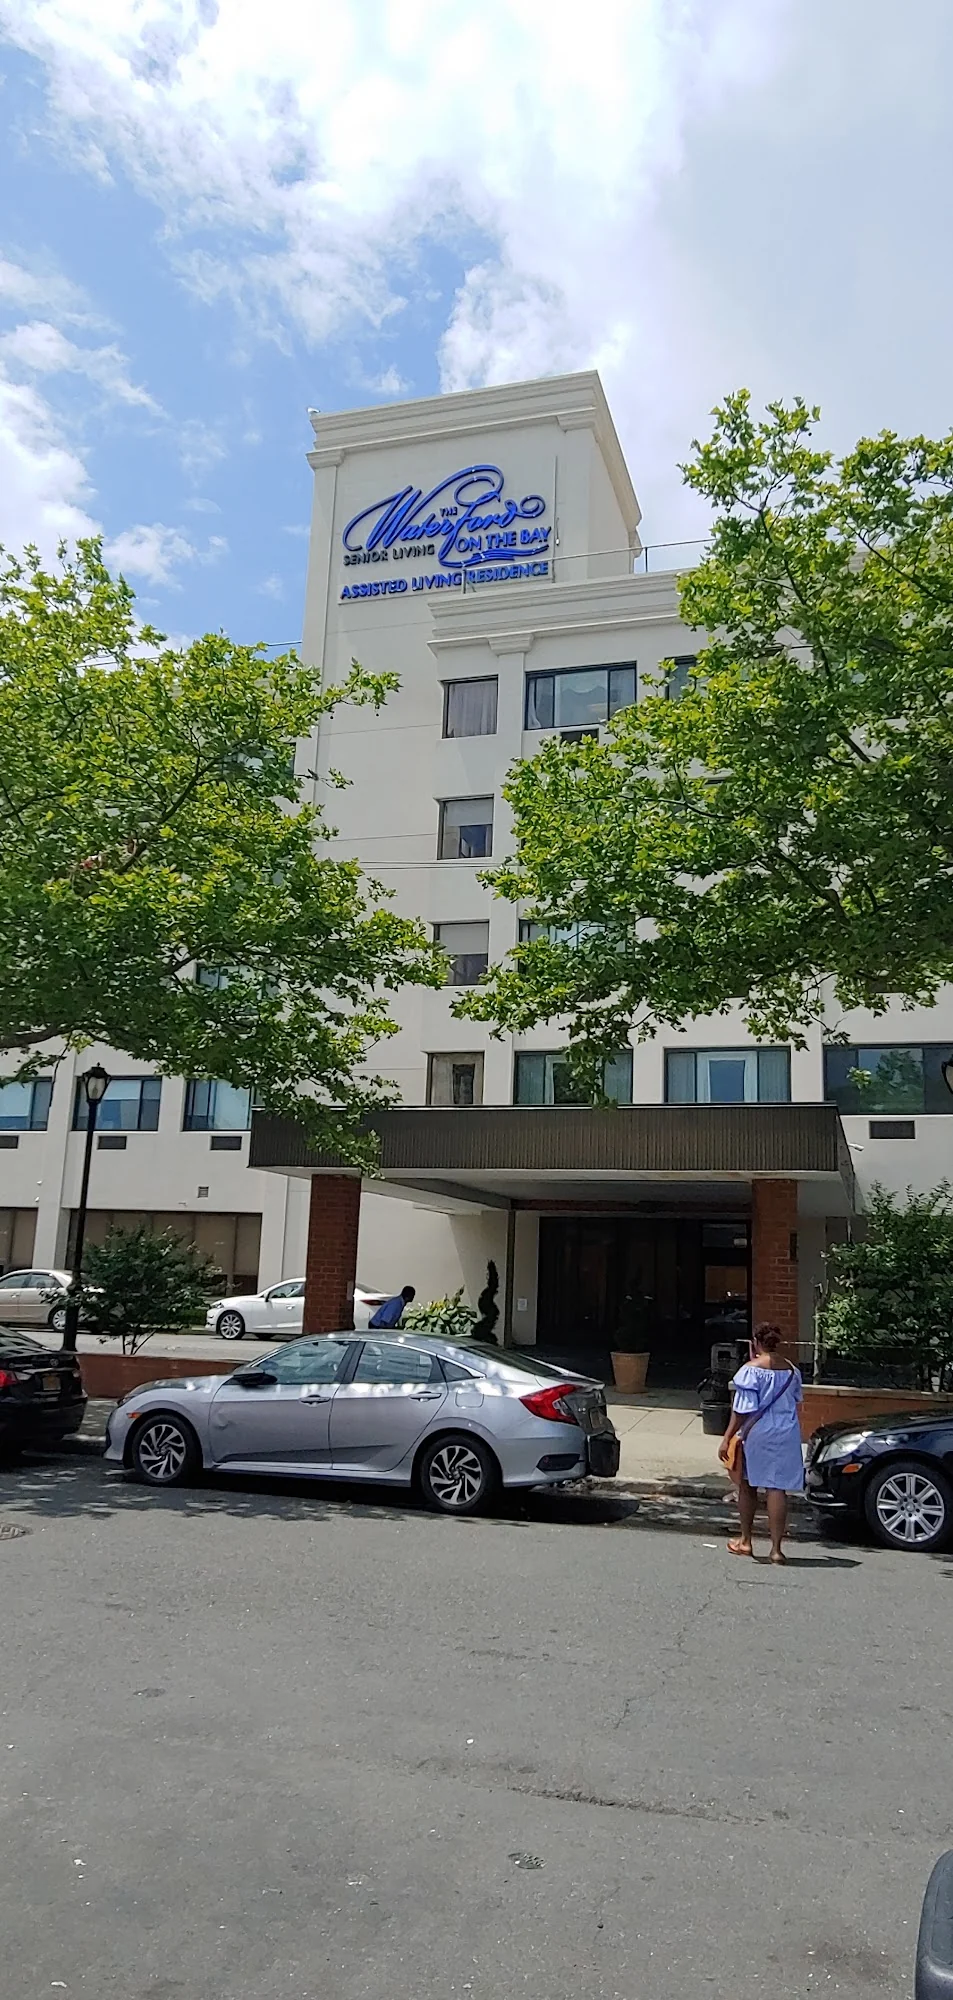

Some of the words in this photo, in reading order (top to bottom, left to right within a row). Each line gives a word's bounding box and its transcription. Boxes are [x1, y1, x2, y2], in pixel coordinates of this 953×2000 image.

[440, 506, 457, 517] THE
[455, 535, 482, 552] ON
[486, 532, 516, 548] THE
[520, 527, 551, 544] BAY
[343, 551, 388, 566] SENIOR
[393, 544, 435, 559] LIVING
[340, 578, 407, 599] ASSISTED
[412, 572, 462, 590] LIVING
[468, 561, 548, 584] RESIDENCE
